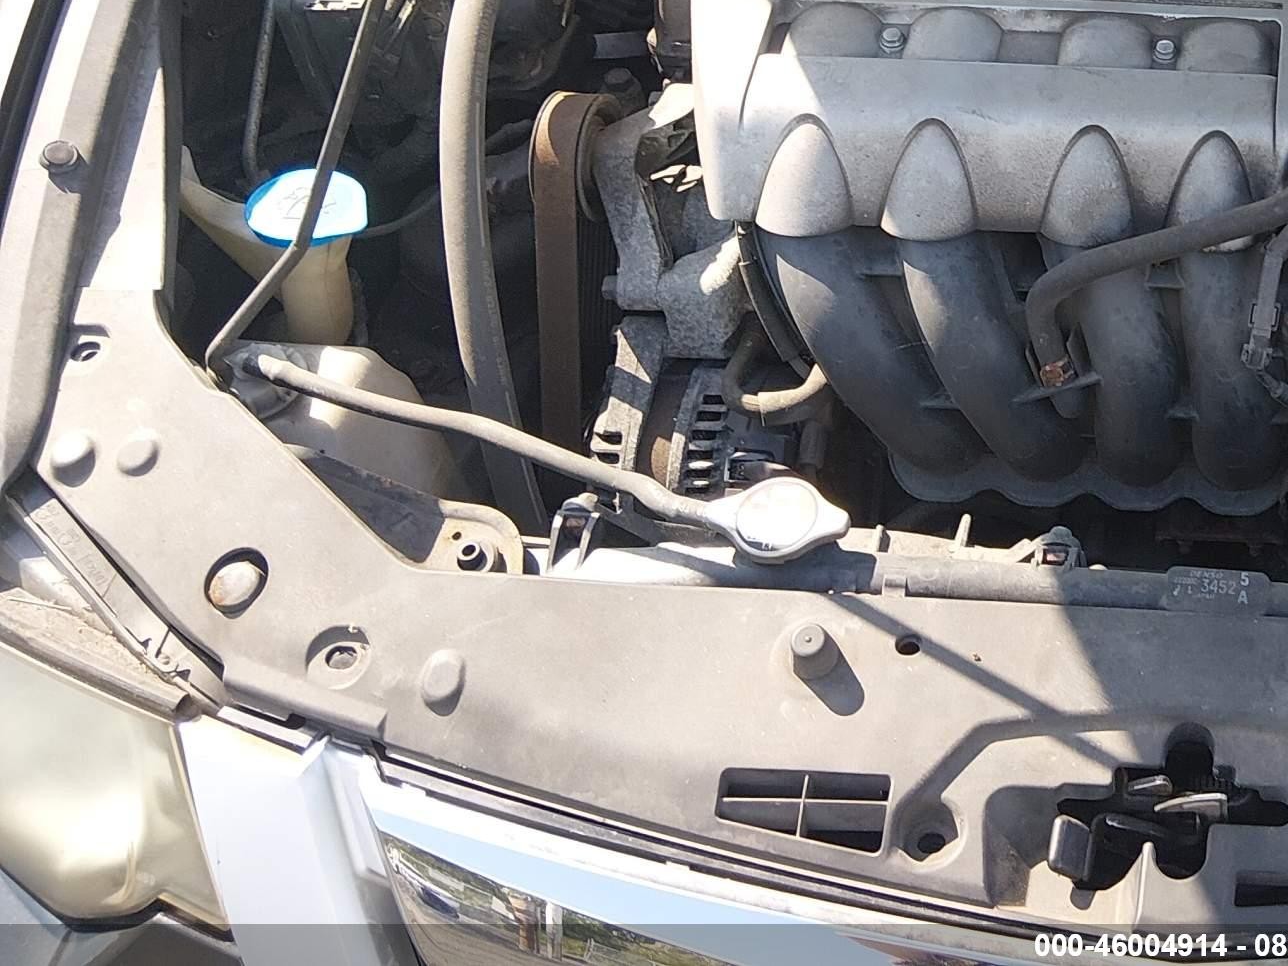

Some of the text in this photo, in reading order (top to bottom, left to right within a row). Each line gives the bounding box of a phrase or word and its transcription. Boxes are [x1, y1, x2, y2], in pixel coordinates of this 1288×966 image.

[1200, 578, 1237, 595] 3452
[1240, 572, 1249, 586] 5
[1237, 590, 1249, 605] A
